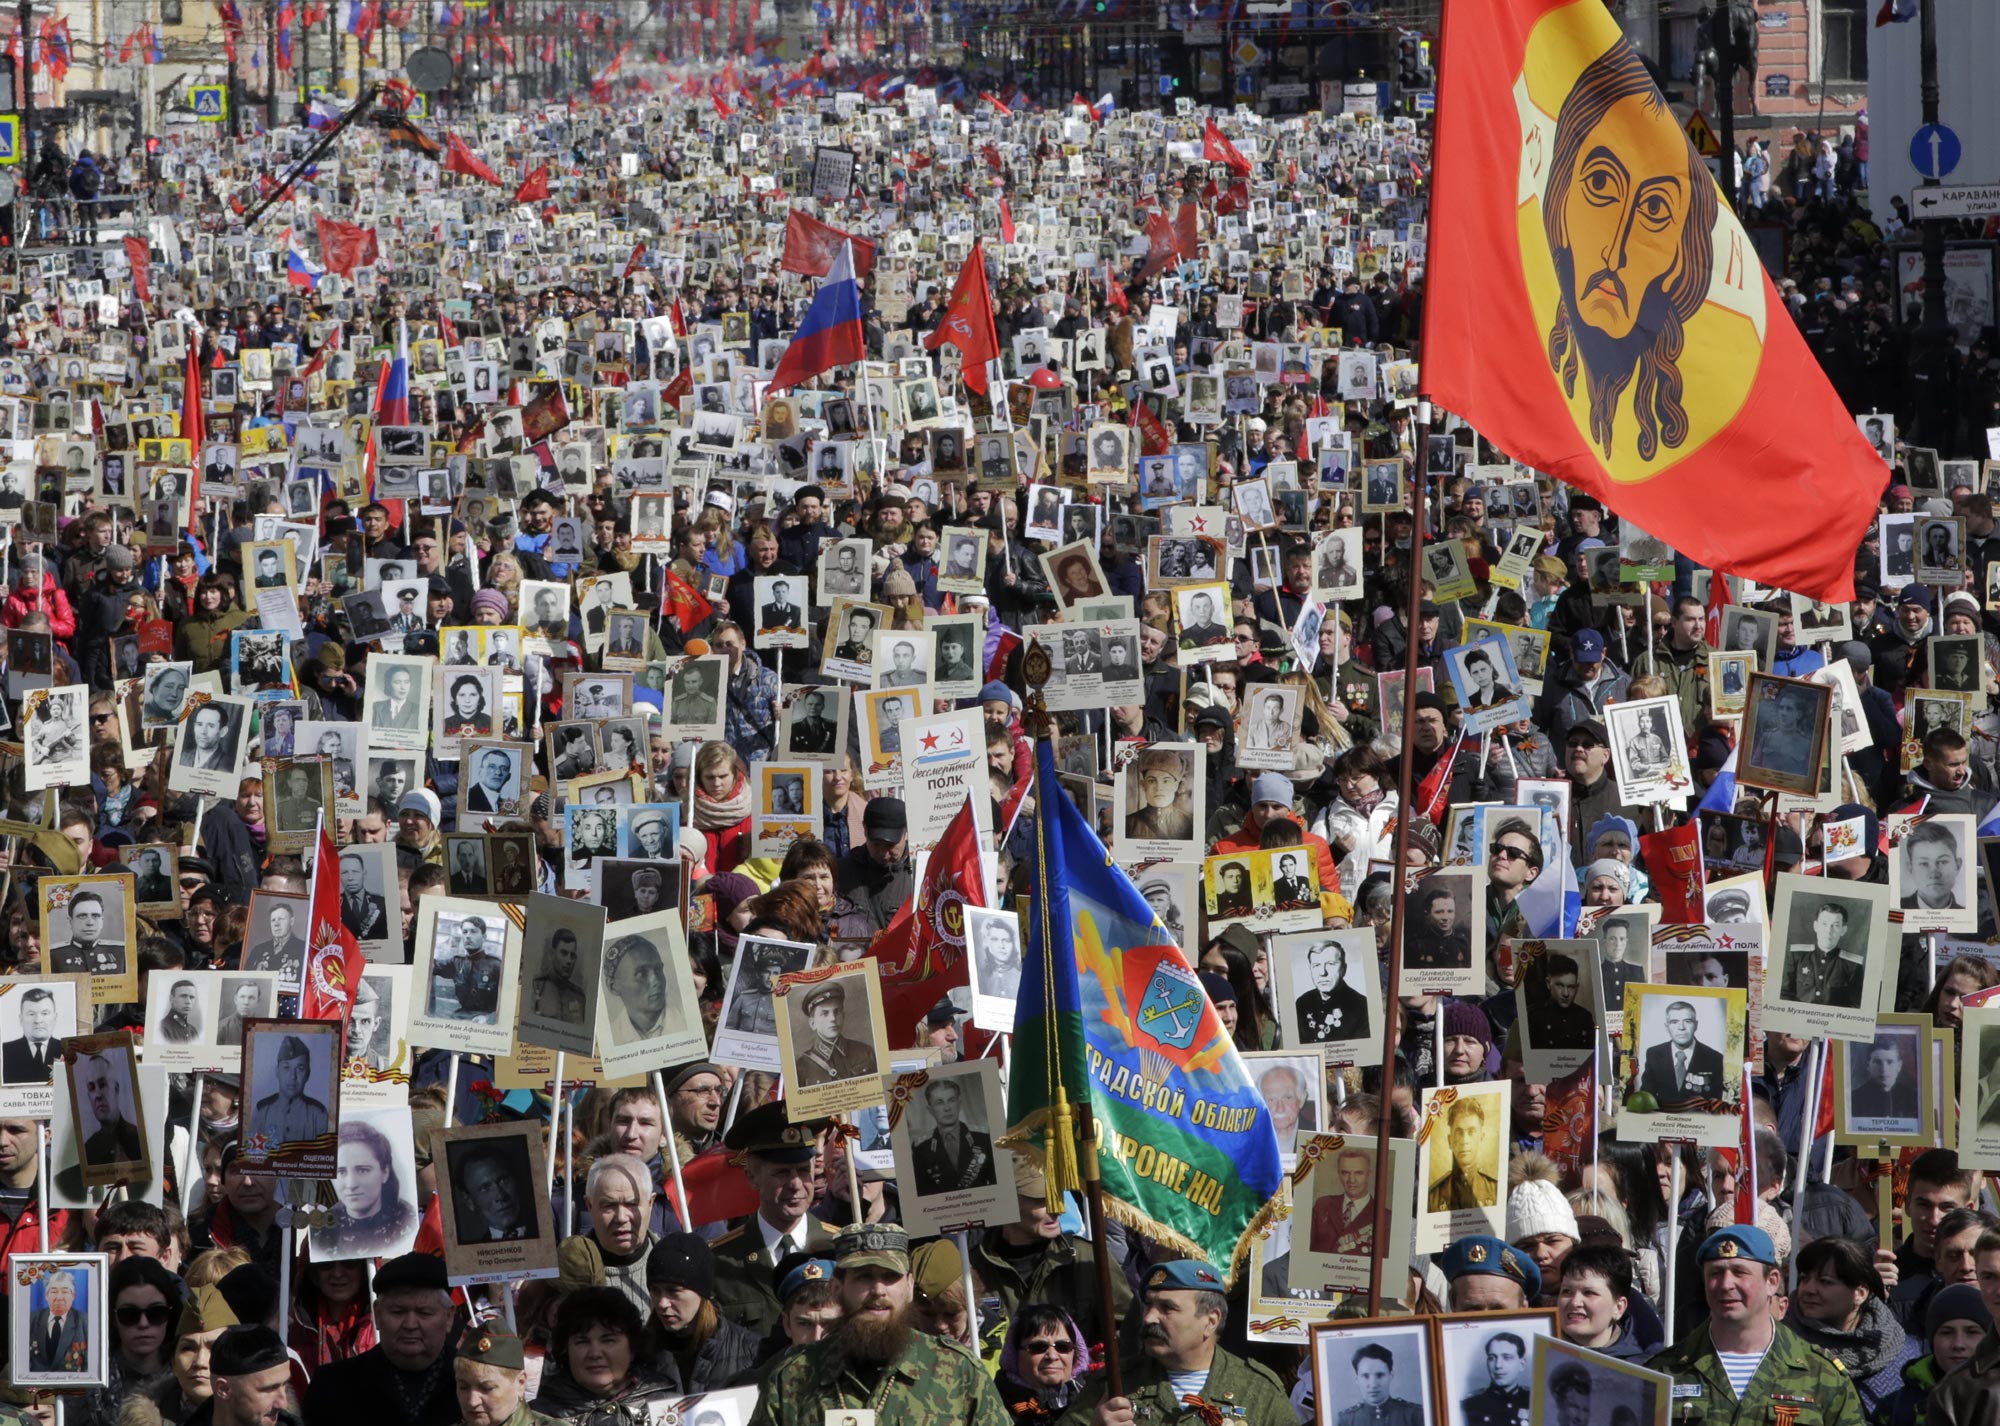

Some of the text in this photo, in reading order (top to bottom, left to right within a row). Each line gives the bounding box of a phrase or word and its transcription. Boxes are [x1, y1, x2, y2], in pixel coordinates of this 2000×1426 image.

[1966, 202, 1997, 212] улица
[928, 774, 964, 790] ПОЛК
[929, 811, 959, 822] Василь
[843, 961, 865, 972] ПОЛК
[1763, 1003, 1786, 1012] Алиев
[1806, 1018, 1829, 1026] майор
[1085, 1043, 1258, 1133] ГРАДСКОЙ ОБЛАСТИ
[1111, 1129, 1191, 1196] КРОМЕ
